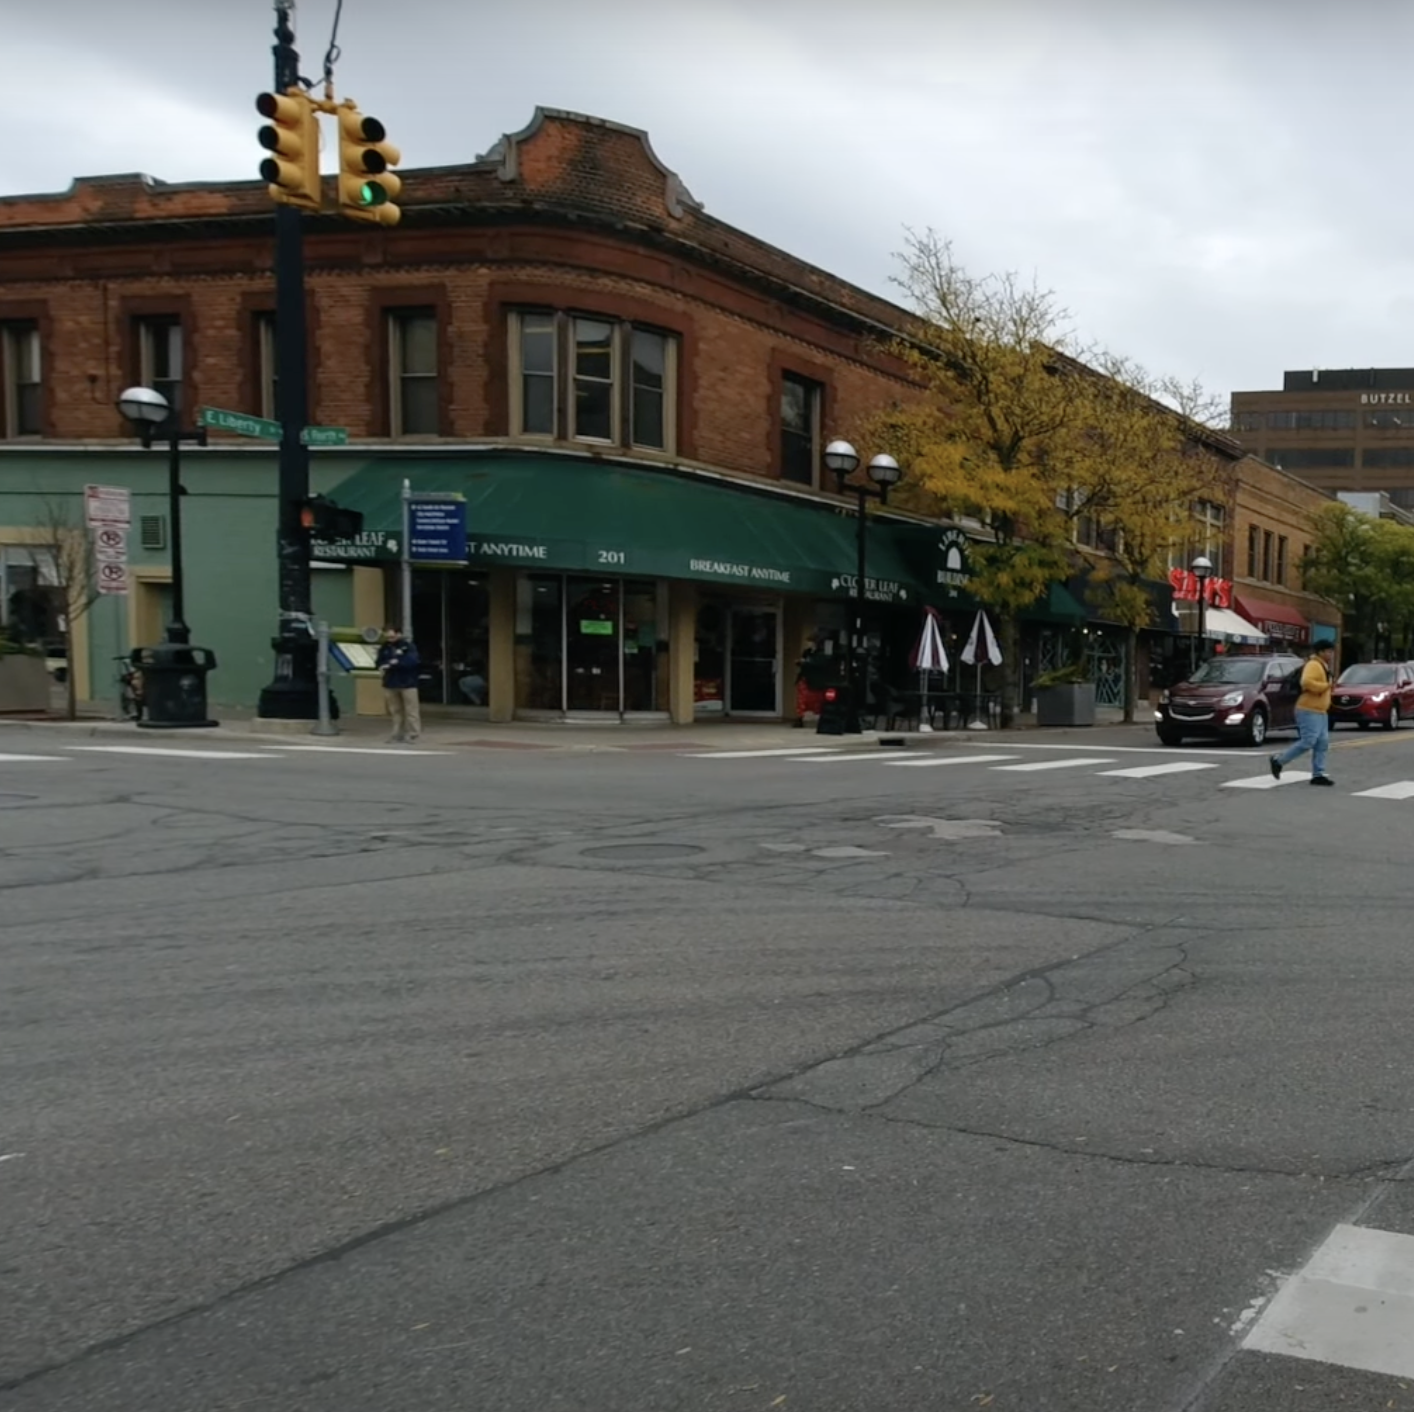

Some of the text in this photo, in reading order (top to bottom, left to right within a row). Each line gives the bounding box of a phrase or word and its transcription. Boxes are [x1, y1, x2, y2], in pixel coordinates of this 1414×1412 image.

[1361, 393, 1411, 404] BUTZEL
[219, 413, 261, 435] Liberty
[355, 531, 386, 546] LEAF
[313, 545, 376, 557] RESTAURANT
[480, 542, 547, 559] ANYTIME
[598, 550, 625, 565] 201
[690, 559, 791, 583] BREAKFAST ANYTIME
[840, 574, 899, 594] CLOER LEAF
